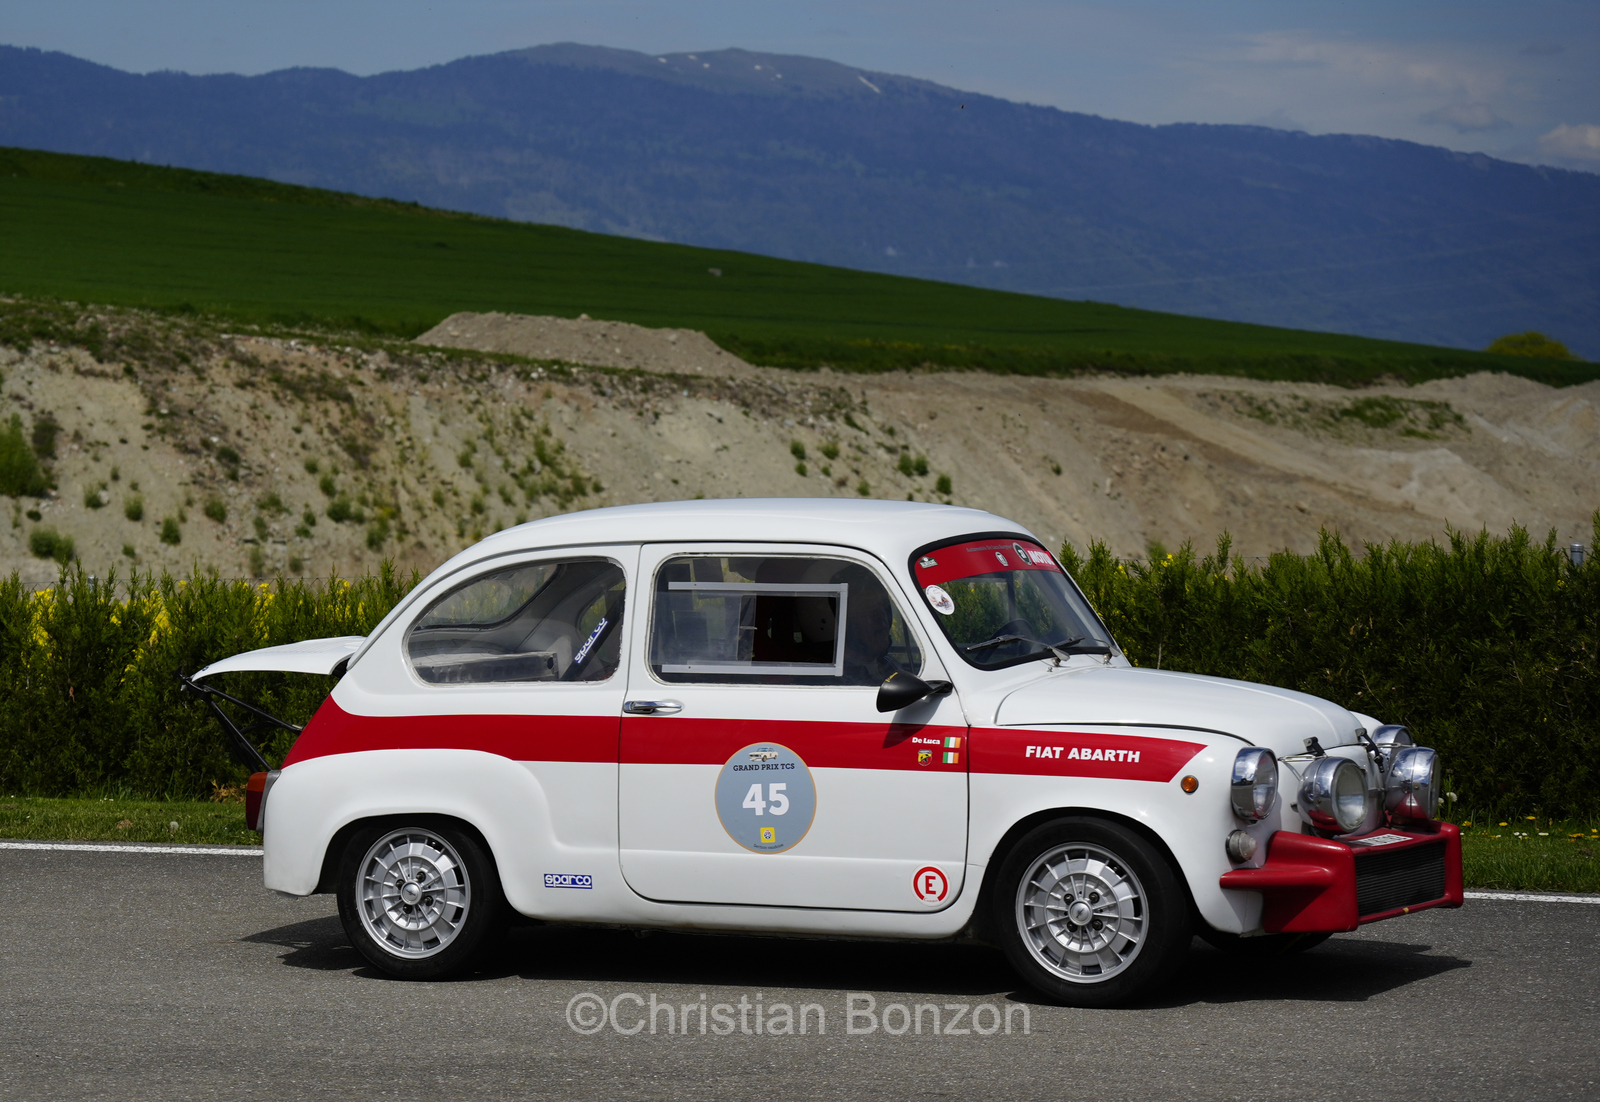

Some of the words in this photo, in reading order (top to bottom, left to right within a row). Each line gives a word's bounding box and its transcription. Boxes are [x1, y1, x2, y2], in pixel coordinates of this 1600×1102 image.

[574, 617, 607, 663] sparco
[1025, 745, 1064, 759] FIAT
[1067, 747, 1140, 763] ABARTH
[780, 762, 795, 770] TCS
[742, 782, 790, 816] 45
[544, 874, 592, 887] sparco
[925, 875, 937, 895] E
